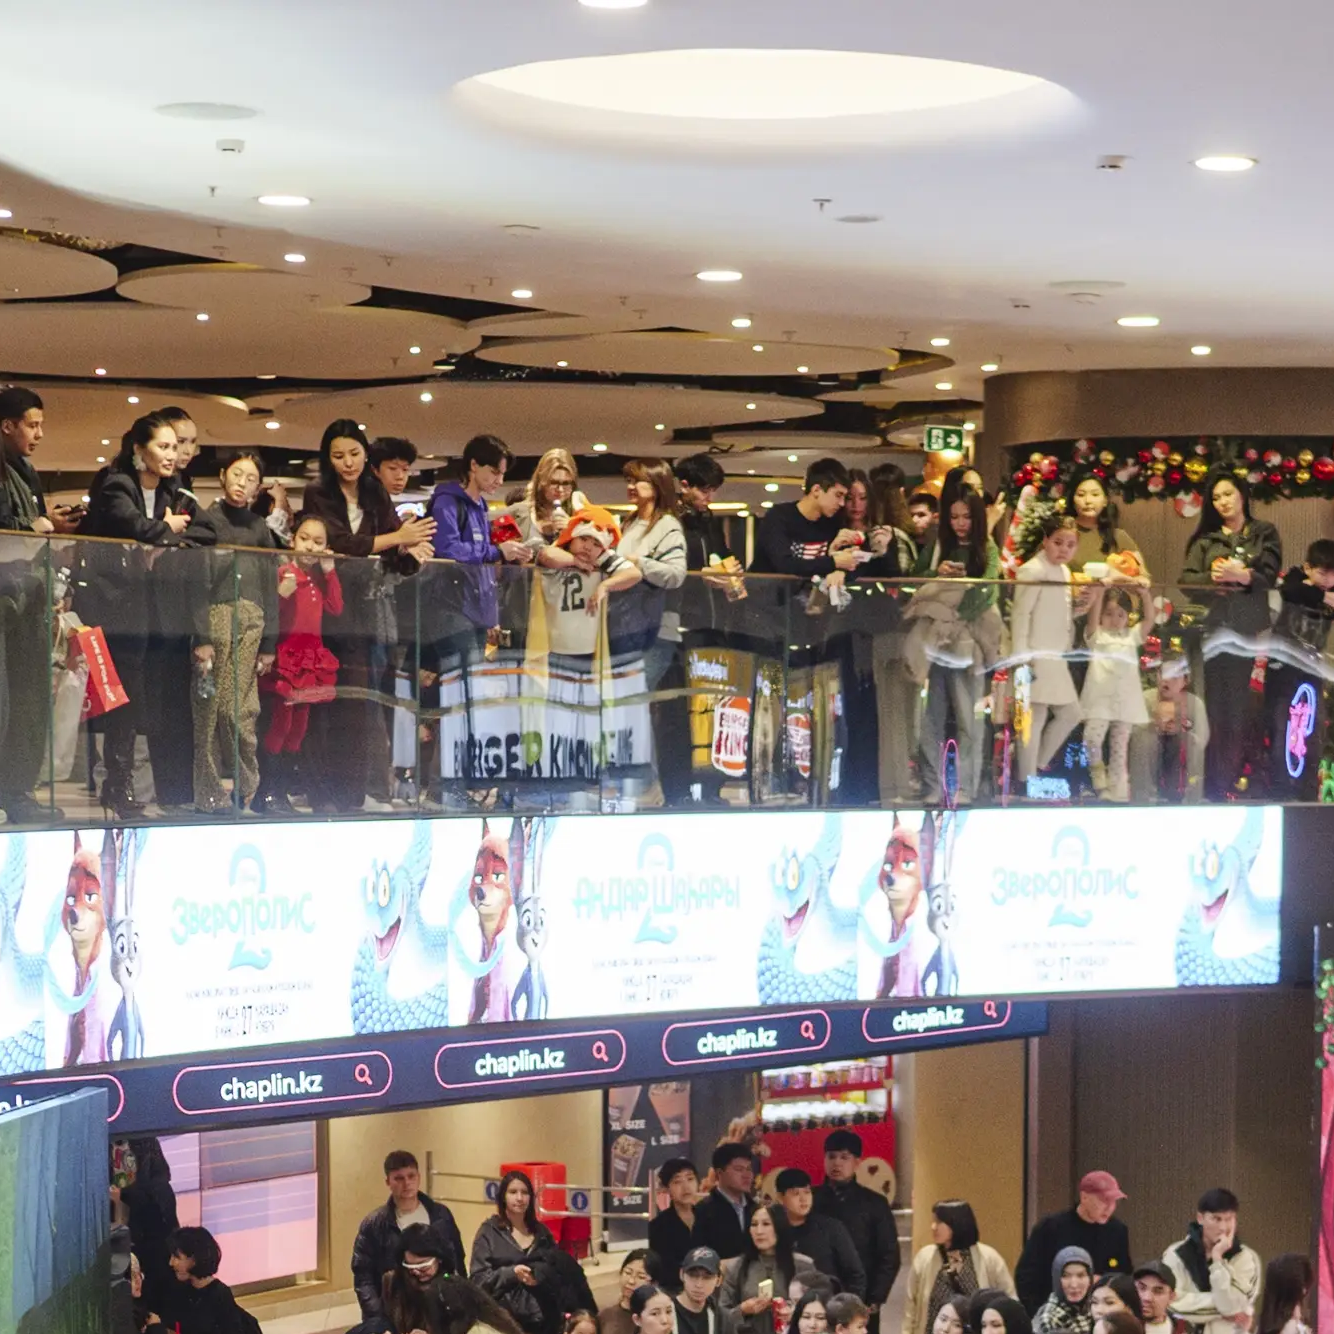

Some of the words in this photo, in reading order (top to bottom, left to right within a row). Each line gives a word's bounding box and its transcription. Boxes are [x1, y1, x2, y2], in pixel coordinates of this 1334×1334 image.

[560, 573, 585, 612] 12
[892, 1006, 965, 1034] chaplin.kz
[697, 1027, 778, 1056] chaplin.kz
[475, 1047, 565, 1078] chaplin.kz
[220, 1070, 323, 1102] chaplin.kz
[625, 1119, 646, 1130] SIZE
[651, 1136, 657, 1146] L
[660, 1134, 680, 1145] SIZE
